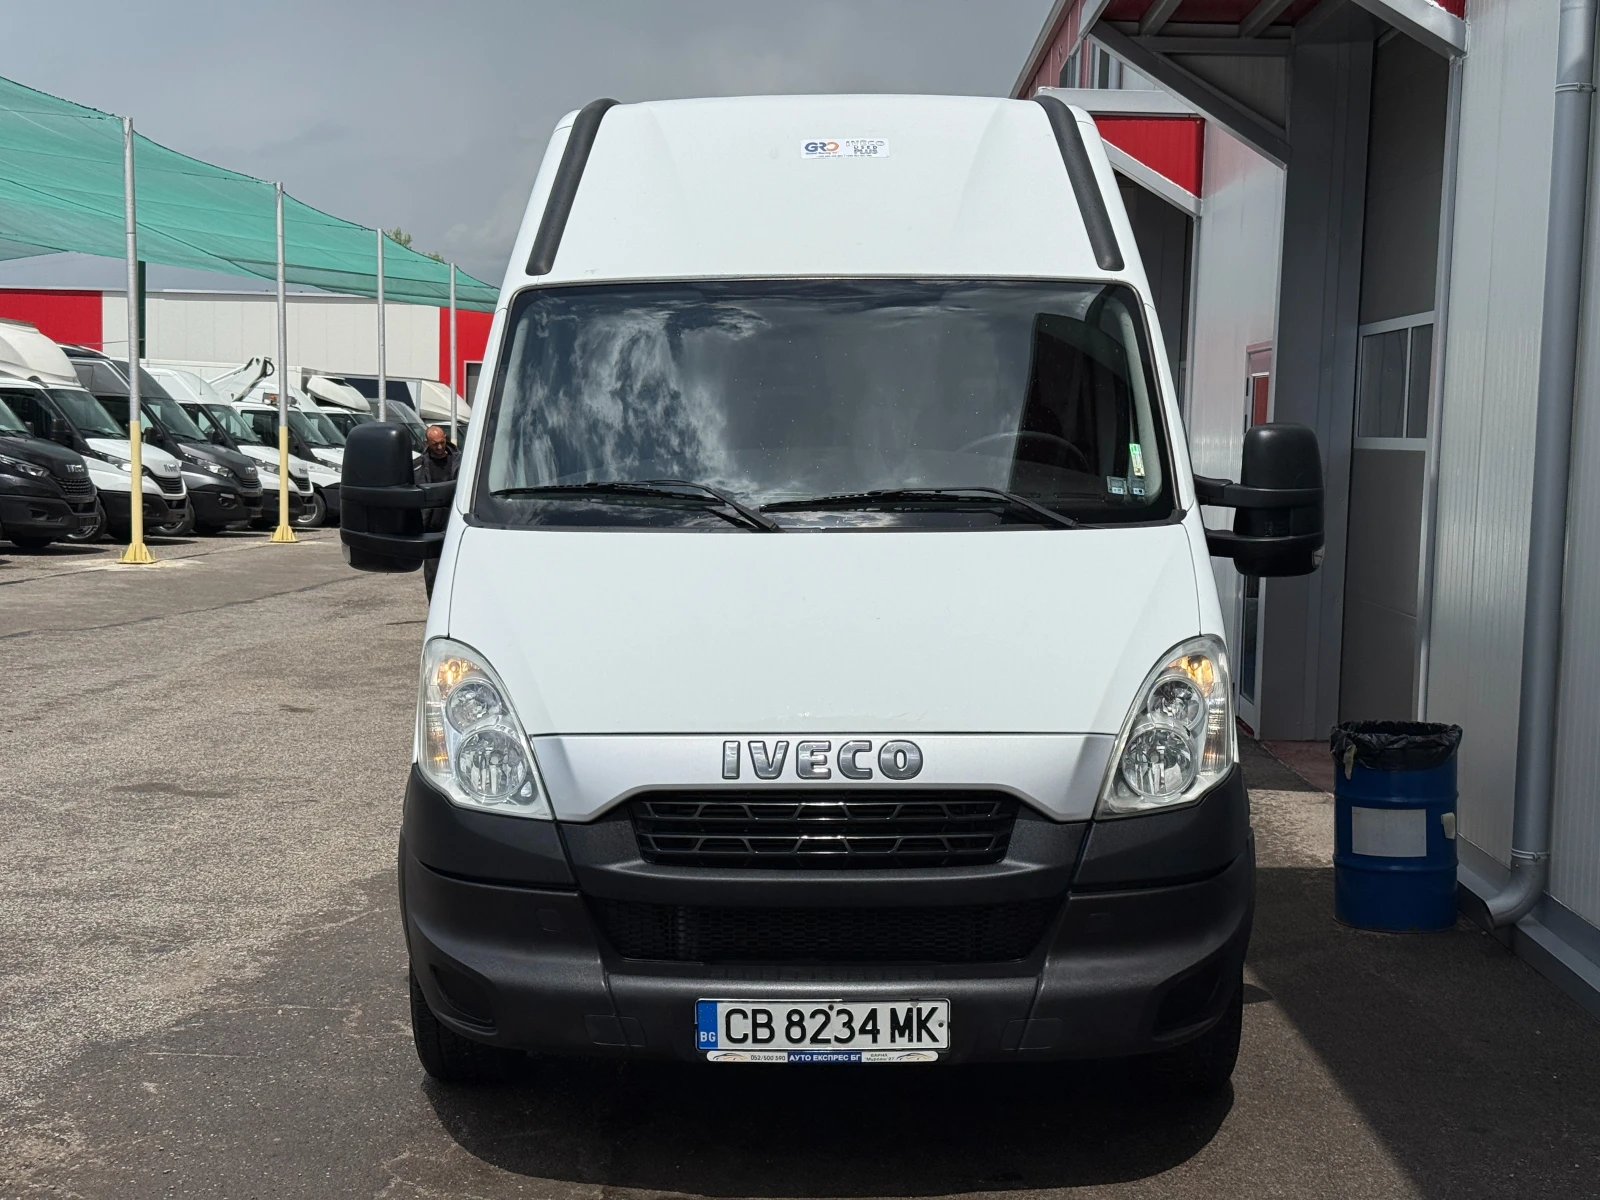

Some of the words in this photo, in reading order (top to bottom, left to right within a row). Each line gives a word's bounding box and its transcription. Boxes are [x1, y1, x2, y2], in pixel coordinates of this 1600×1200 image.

[722, 739, 923, 780] IVECO
[700, 1031, 716, 1042] BG
[725, 1007, 775, 1044] CB
[784, 1007, 880, 1044] 8234
[889, 1006, 940, 1043] MK
